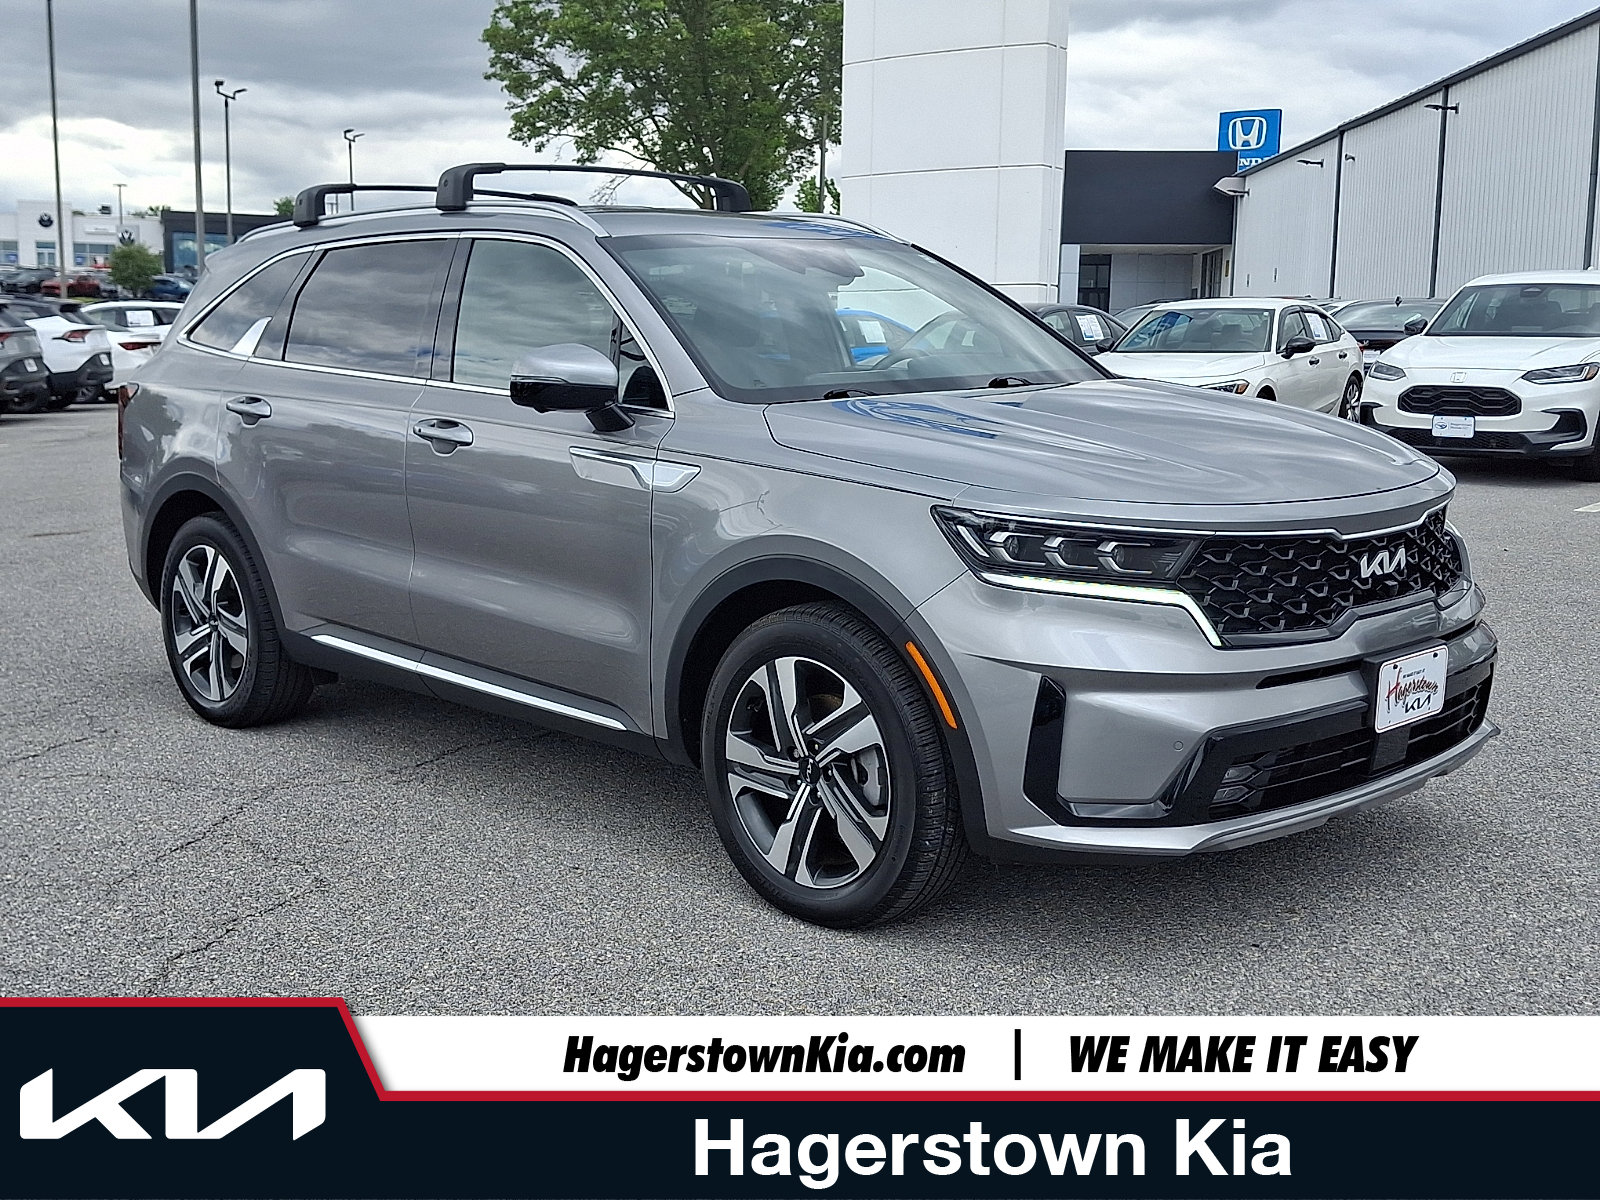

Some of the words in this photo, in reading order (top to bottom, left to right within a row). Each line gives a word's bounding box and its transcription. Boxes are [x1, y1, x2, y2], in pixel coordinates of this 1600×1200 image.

[1360, 548, 1406, 578] KIA
[1385, 667, 1438, 712] Hagerstown
[1405, 694, 1431, 713] KIA
